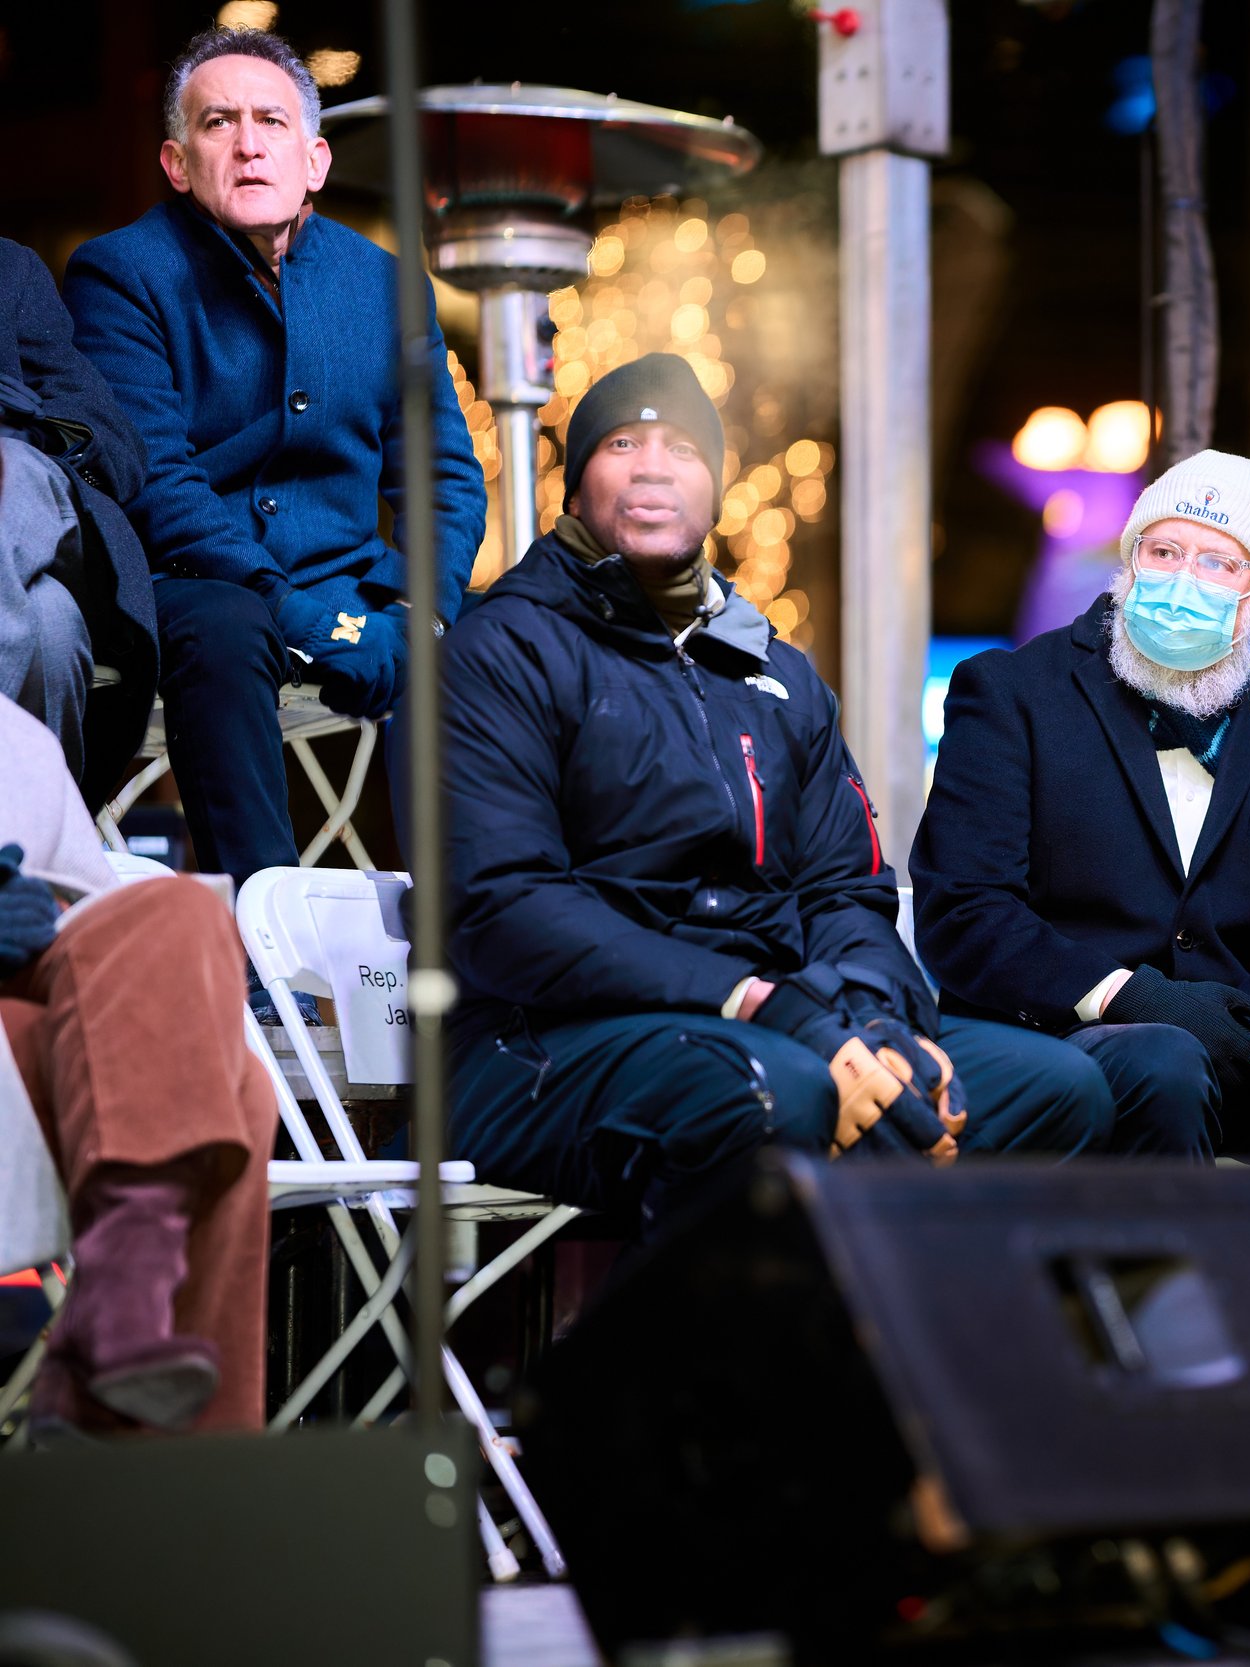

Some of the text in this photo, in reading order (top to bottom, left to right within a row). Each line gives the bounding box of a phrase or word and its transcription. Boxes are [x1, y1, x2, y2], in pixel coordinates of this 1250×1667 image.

[331, 611, 367, 645] M
[358, 965, 404, 992] Rep.
[384, 1003, 408, 1025] Ja
